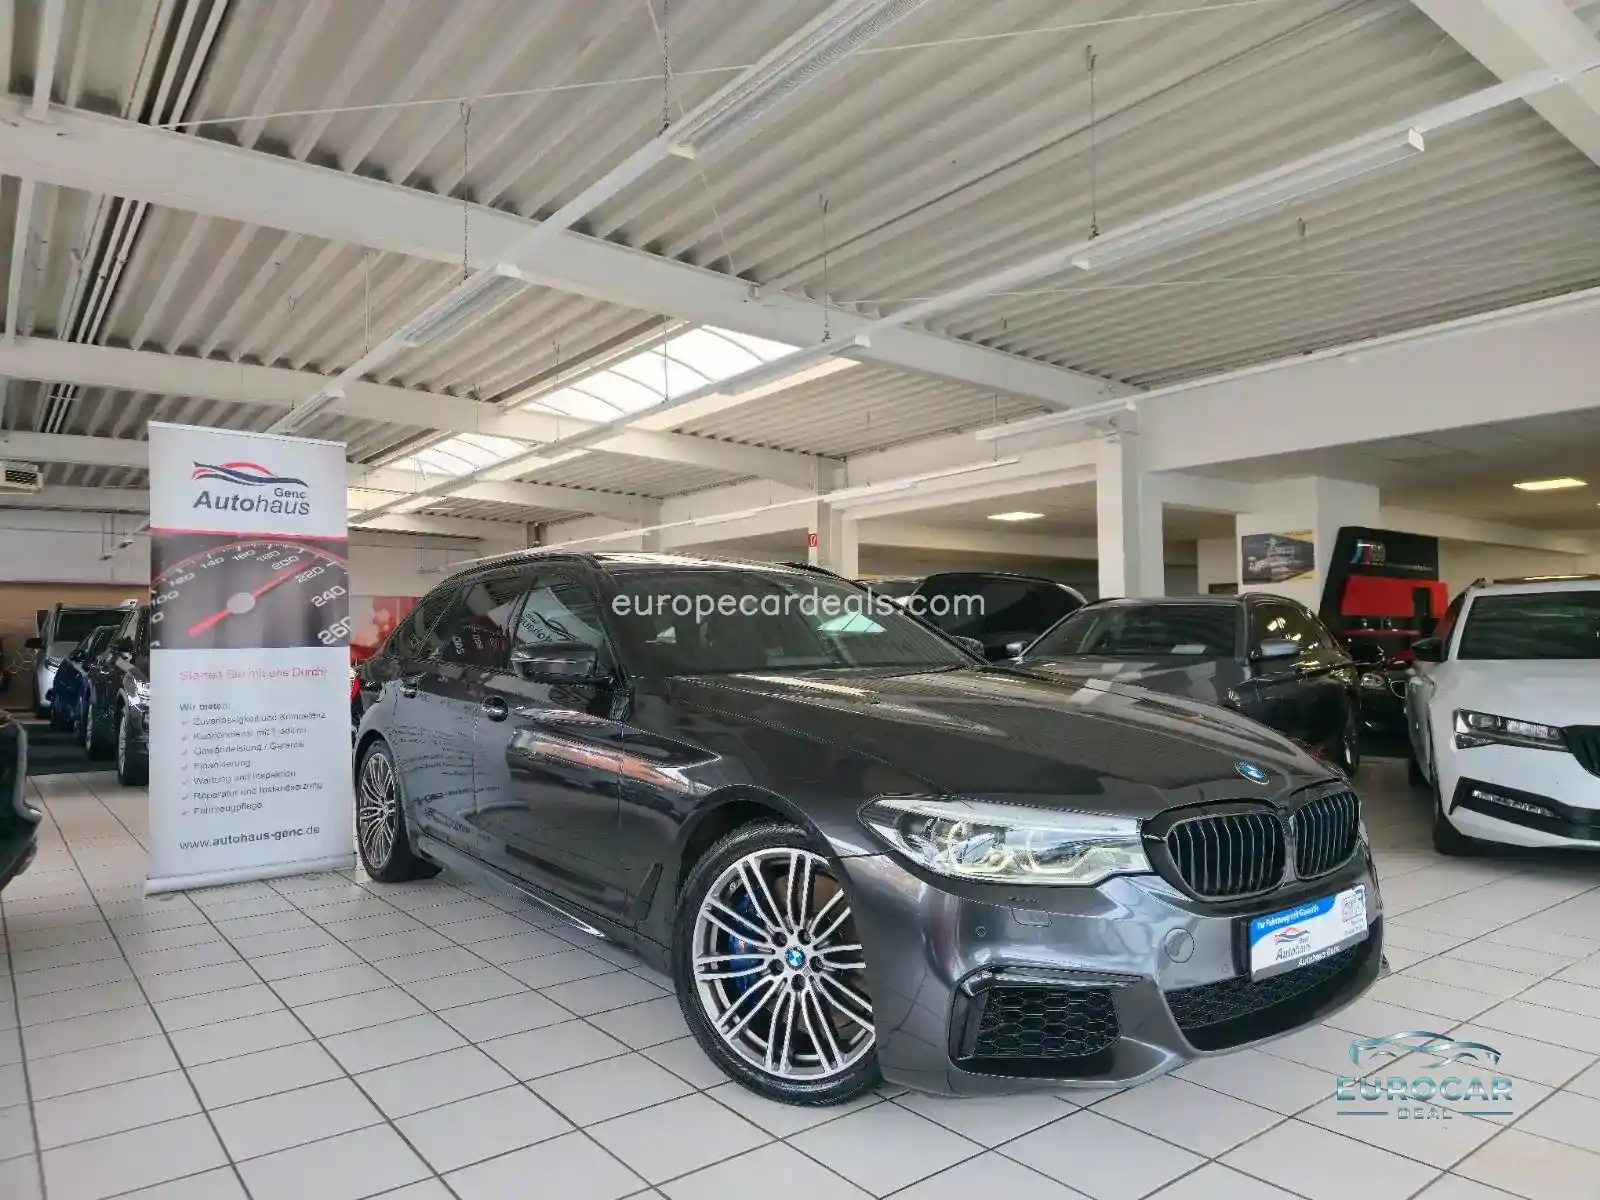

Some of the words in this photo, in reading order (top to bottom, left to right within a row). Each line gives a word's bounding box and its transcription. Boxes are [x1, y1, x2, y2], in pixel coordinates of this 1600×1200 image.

[275, 487, 306, 499] Genc
[193, 490, 310, 515] Autohaus
[200, 556, 224, 569] 140
[271, 555, 299, 570] 200
[168, 572, 195, 586] 120
[295, 566, 325, 585] 220
[311, 585, 346, 607] 240
[179, 702, 196, 712] Wir
[179, 825, 320, 850] www.autohaus-genc.de
